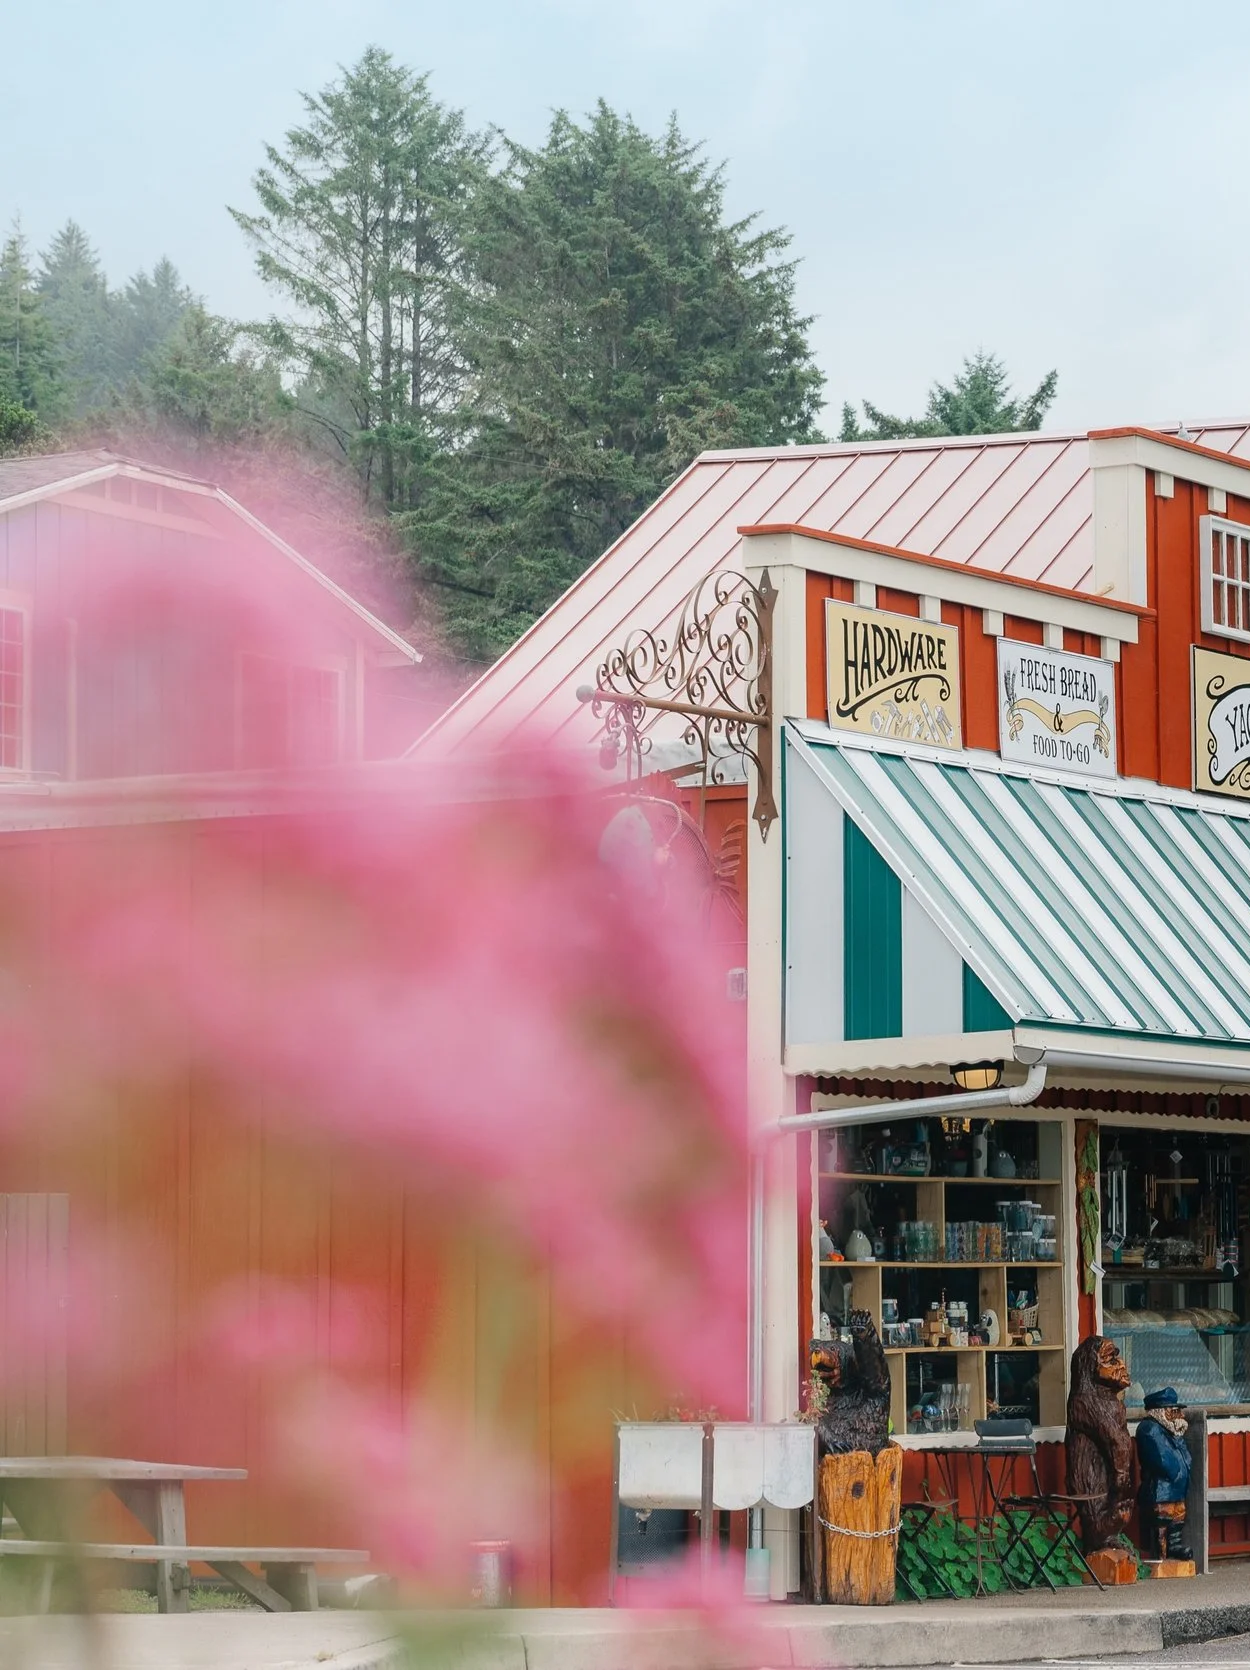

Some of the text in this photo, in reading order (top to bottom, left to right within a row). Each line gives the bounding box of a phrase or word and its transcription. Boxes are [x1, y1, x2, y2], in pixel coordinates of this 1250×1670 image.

[842, 618, 947, 706] HARDWARE
[1020, 658, 1097, 703] FRESH BREAD
[1053, 702, 1064, 733] &
[1033, 734, 1058, 758] FOOD
